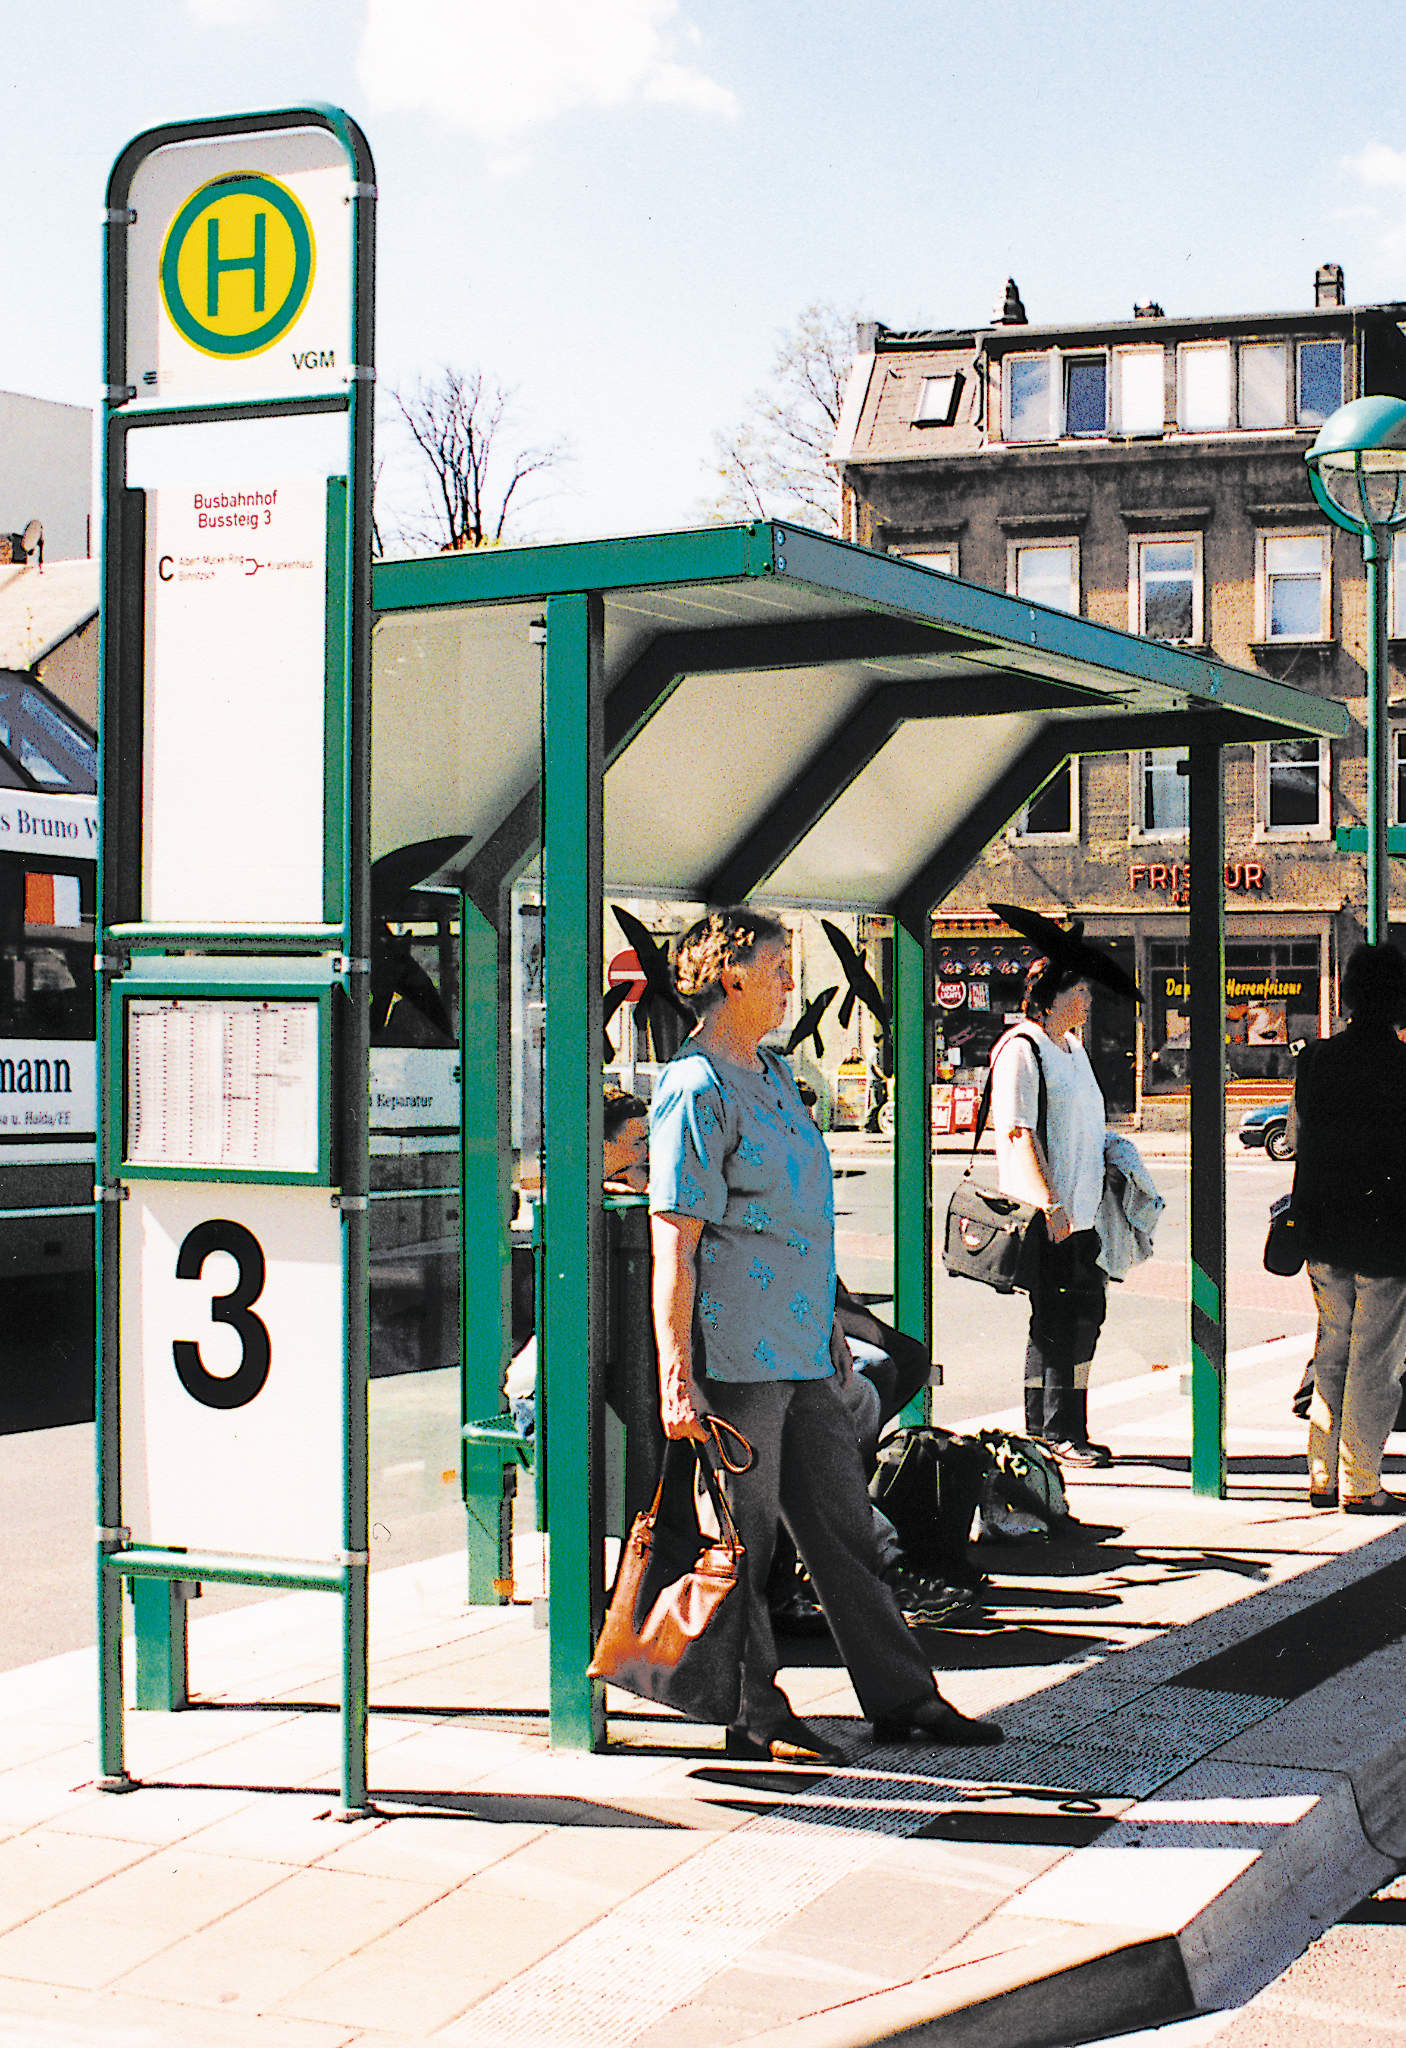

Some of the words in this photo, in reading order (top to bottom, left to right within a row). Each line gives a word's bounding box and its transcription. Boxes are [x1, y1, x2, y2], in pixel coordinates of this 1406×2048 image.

[207, 213, 266, 317] H
[291, 350, 336, 370] VGM
[193, 489, 279, 509] Busbahnhof
[198, 512, 259, 530] Bussteig
[264, 509, 272, 525] 3
[158, 555, 175, 582] C
[17, 808, 79, 840] Bruno
[1128, 863, 1263, 890] FRISUR
[376, 1094, 434, 1111] Reparatur
[172, 1218, 272, 1410] 3
